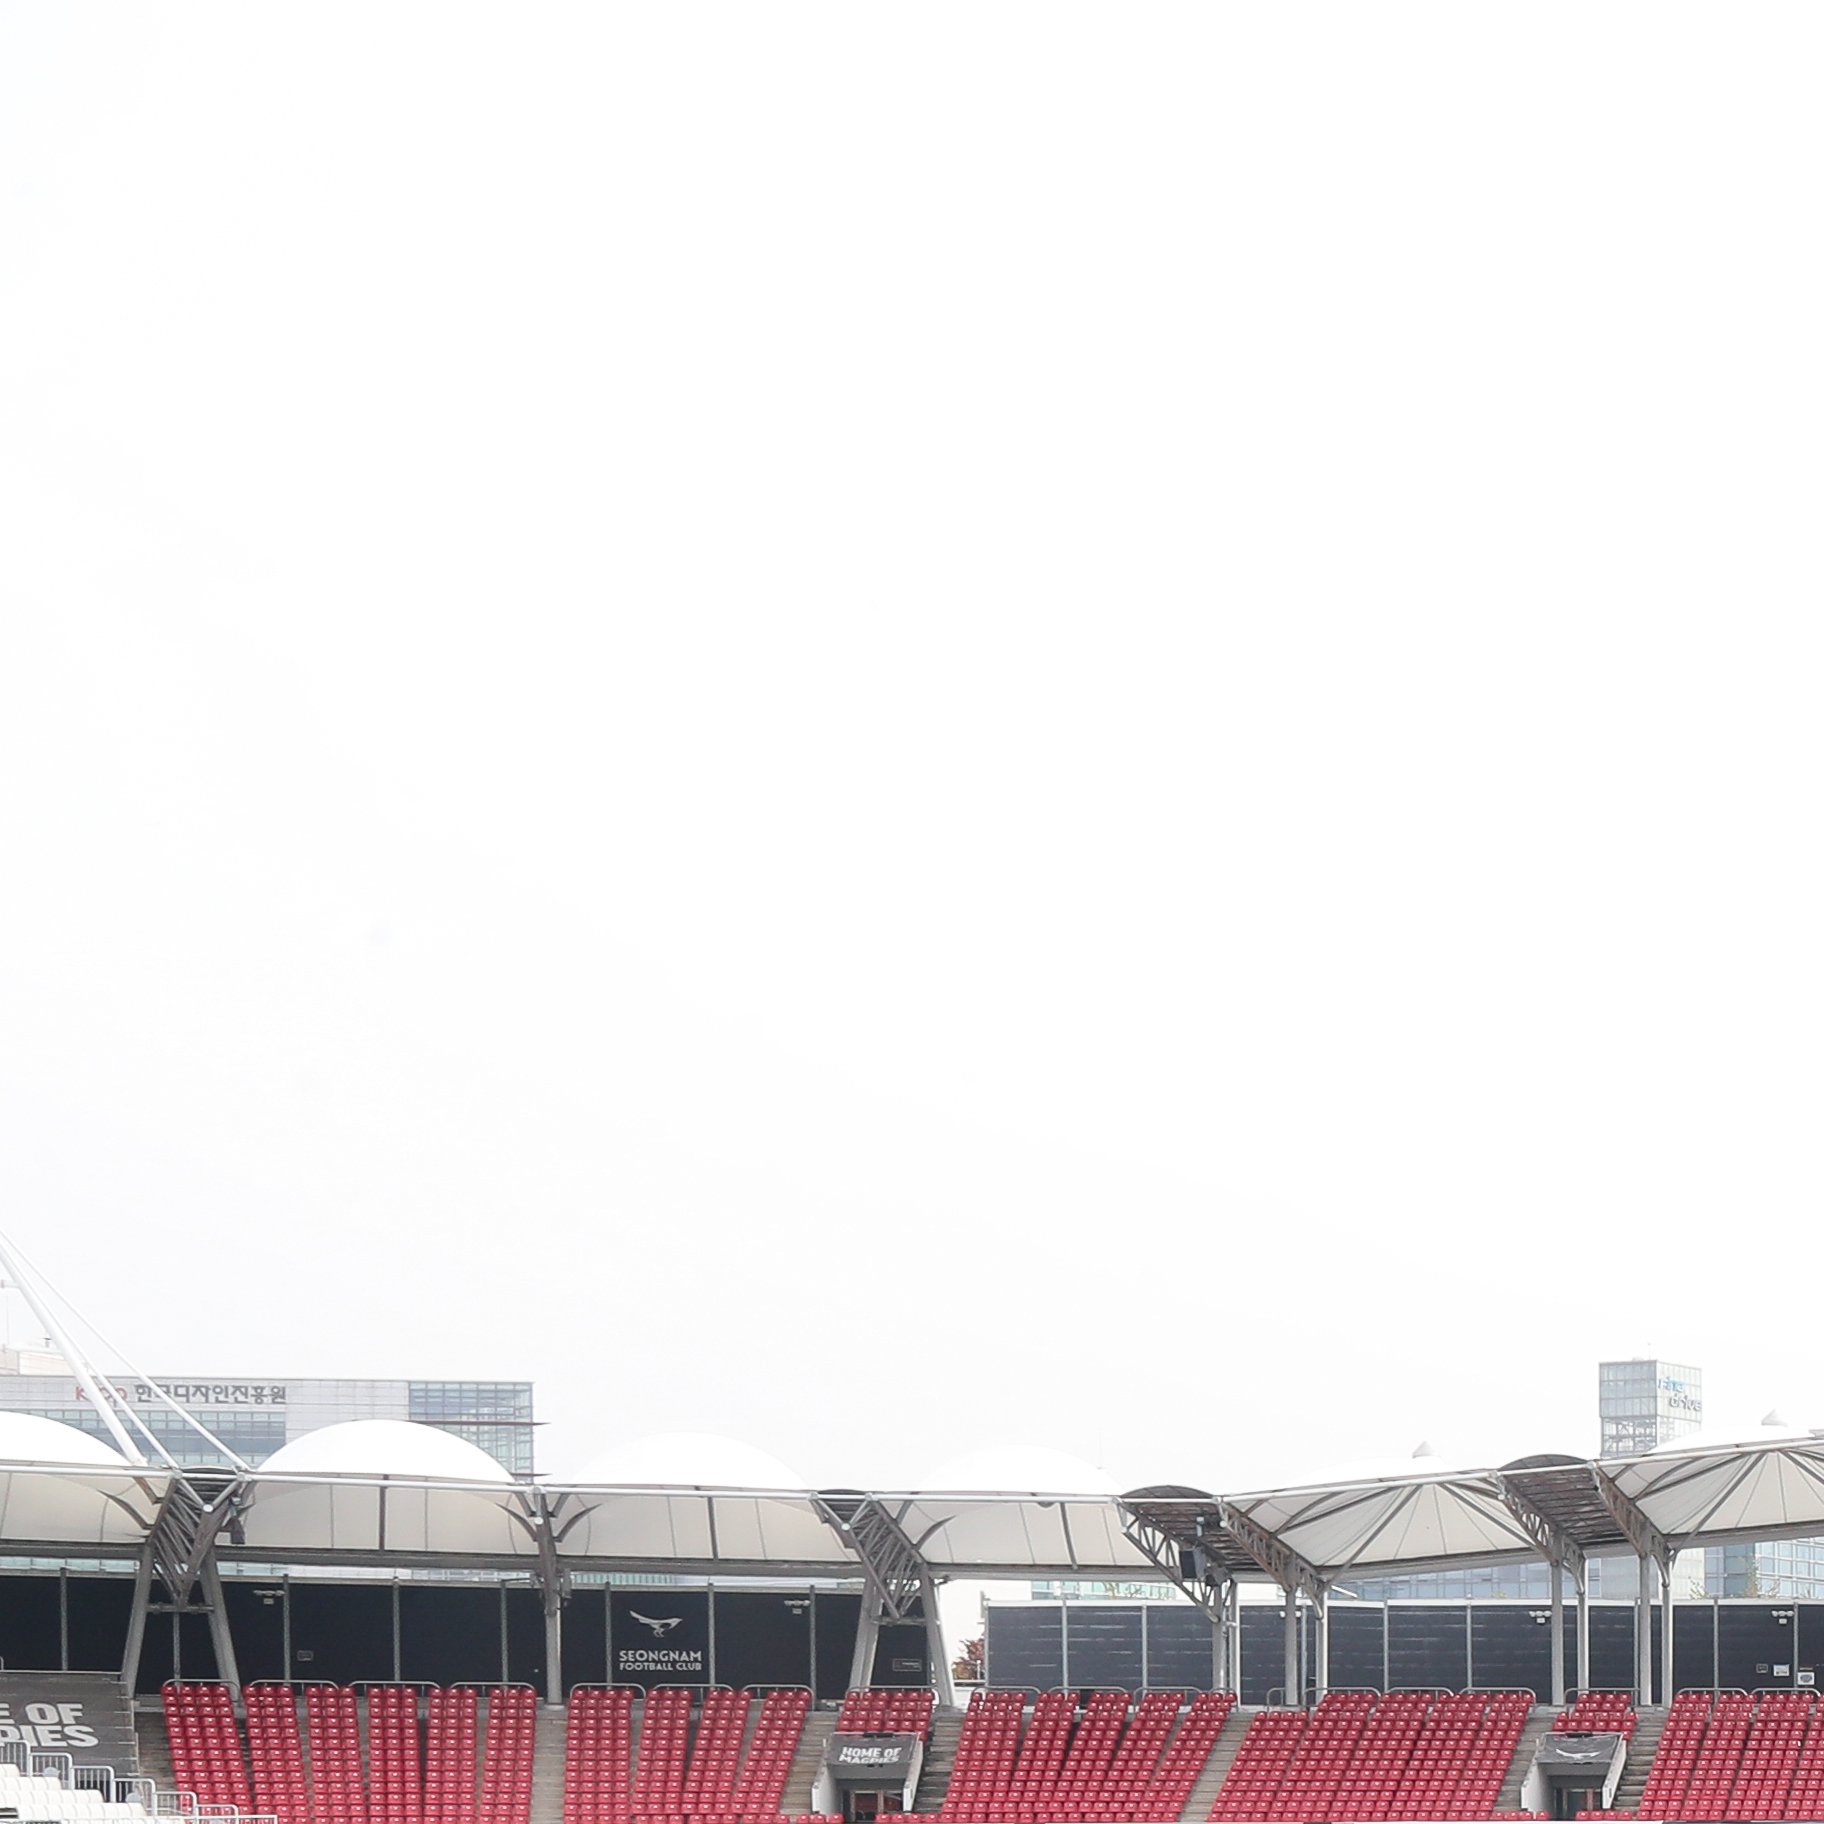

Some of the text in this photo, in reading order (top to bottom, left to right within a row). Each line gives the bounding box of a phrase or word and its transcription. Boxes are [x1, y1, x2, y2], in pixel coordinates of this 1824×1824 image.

[619, 1650, 702, 1661] SEONGNAM
[620, 1662, 702, 1671] FOOTBALL CLUB
[25, 1702, 83, 1725] OF
[841, 1746, 902, 1758] HOME OF
